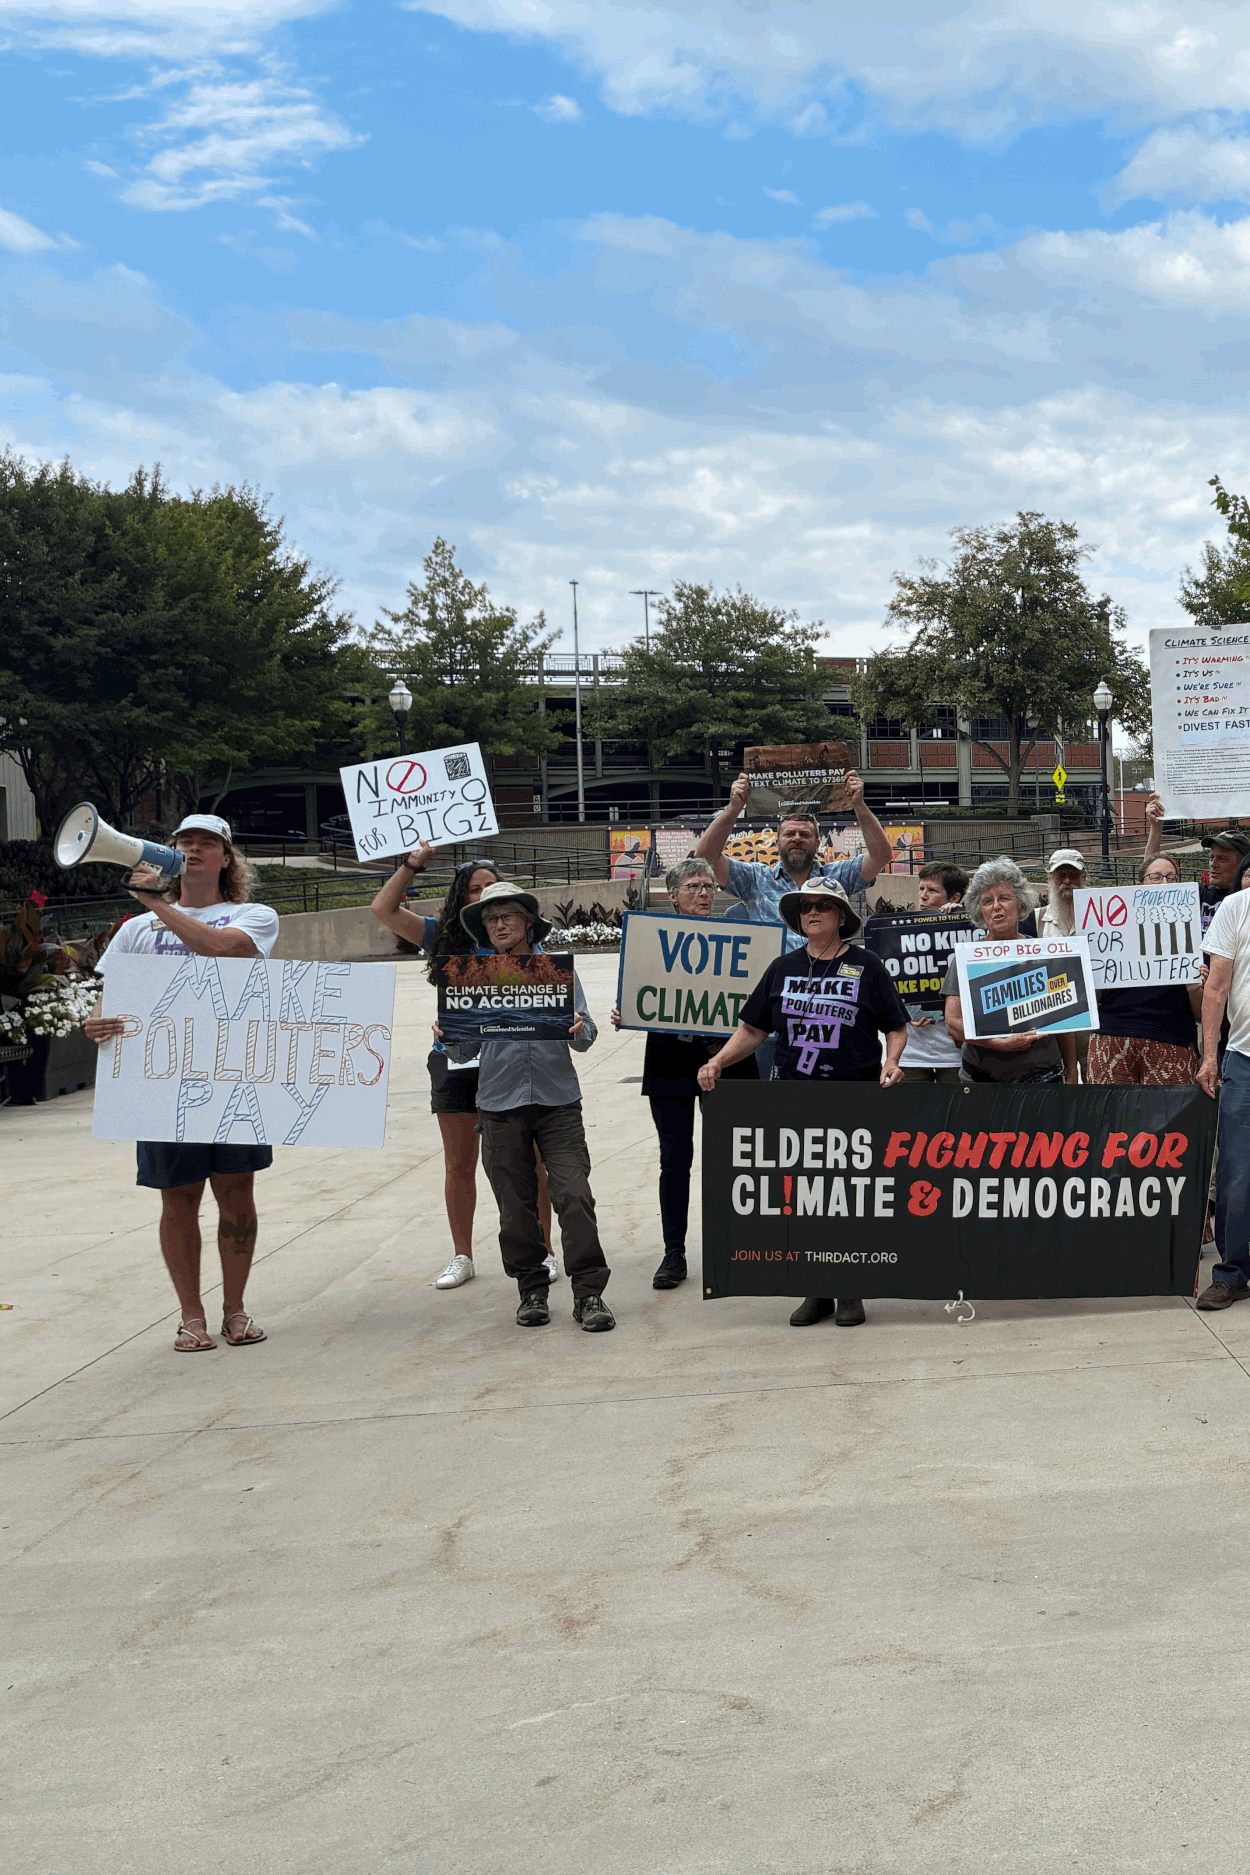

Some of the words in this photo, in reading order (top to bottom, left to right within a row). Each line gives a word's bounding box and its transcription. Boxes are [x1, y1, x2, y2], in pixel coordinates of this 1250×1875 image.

[1164, 638, 1207, 648] CLIMATE
[1211, 635, 1249, 645] SCIENCE
[1182, 657, 1199, 665] IT'S
[1202, 655, 1243, 664] WARMING
[1183, 670, 1199, 678] IT'S
[1183, 682, 1210, 690] WE'RE
[1184, 696, 1200, 704] IT'S
[1185, 709, 1199, 717] WE
[1183, 721, 1220, 731] DIVEST
[749, 772, 774, 780] MAKE
[776, 769, 826, 779] POLLUTERS
[829, 768, 845, 776] PAY
[773, 777, 806, 786] CLIMATE
[368, 790, 456, 818] IMMUNITY
[358, 827, 387, 856] FOR
[397, 803, 473, 847] BIG
[914, 916, 938, 924] POWER
[900, 932, 932, 953] NO
[974, 945, 1010, 957] STOP
[1016, 944, 1041, 955] BIG
[1047, 943, 1073, 953] OIL
[1088, 931, 1123, 953] FOR
[658, 928, 751, 978] VOTE
[881, 958, 900, 977] O
[150, 955, 351, 1024] MAKE
[446, 985, 498, 996] CLIMATE
[501, 984, 554, 995] CHANGE
[557, 984, 568, 993] IS
[787, 980, 854, 997] MAKE
[984, 971, 1045, 1009] FAMILIES
[1049, 978, 1066, 990] OVER
[446, 996, 473, 1009] NO
[478, 994, 568, 1009] ACCIDENT
[636, 985, 752, 1027] CLIMAT
[786, 998, 854, 1021] POLLUTERS
[1012, 988, 1073, 1020] BILLIONAIRES
[792, 1022, 836, 1043] PAY
[111, 1014, 391, 1086] POLLUTERS
[175, 1078, 331, 1145] PAY
[732, 1127, 873, 1170] ELDERS
[883, 1131, 1090, 1170] FIGHTING
[1101, 1131, 1189, 1169] FOR
[731, 1174, 895, 1218] CL!MATE
[907, 1180, 942, 1216] &
[952, 1176, 1187, 1218] DEMOCRACY
[731, 1250, 760, 1261] JOIN
[764, 1250, 783, 1261] US
[786, 1251, 800, 1262] AT
[805, 1251, 898, 1263] THIRDACT.ORG
